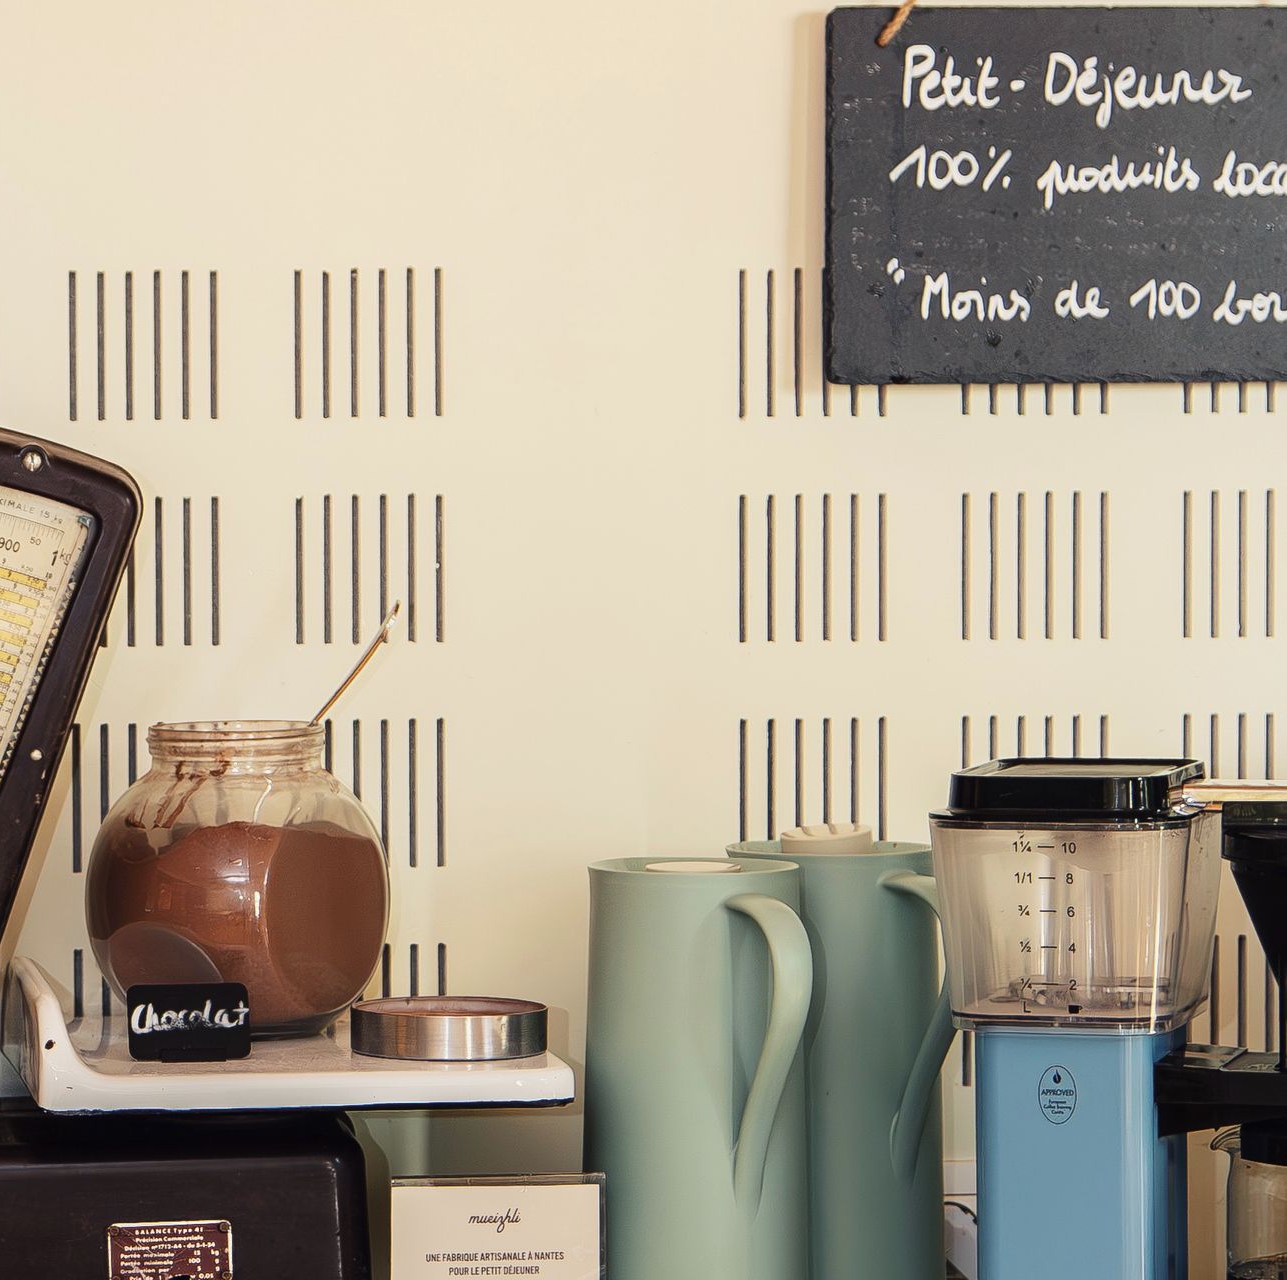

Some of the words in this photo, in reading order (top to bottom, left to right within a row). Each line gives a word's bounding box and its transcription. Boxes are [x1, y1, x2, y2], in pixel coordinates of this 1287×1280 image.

[889, 145, 1012, 192] 100%
[1036, 145, 1201, 210] produits
[1054, 280, 1110, 321] de
[1129, 278, 1201, 320] 100
[1061, 842, 1077, 854] 10
[1065, 873, 1074, 884] 8
[1066, 906, 1075, 918] 6
[1068, 943, 1076, 954] 4
[1069, 980, 1077, 991] 2
[131, 999, 250, 1035] Chocolat
[426, 1253, 441, 1262] UNE
[442, 1252, 479, 1262] FABRIQUE
[480, 1252, 526, 1261] ARTISANALE
[534, 1251, 564, 1260] NANTES
[449, 1267, 469, 1276] POUR
[471, 1267, 479, 1275] LE
[481, 1266, 502, 1275] PETIT
[503, 1264, 540, 1275] DÉJEUNER
